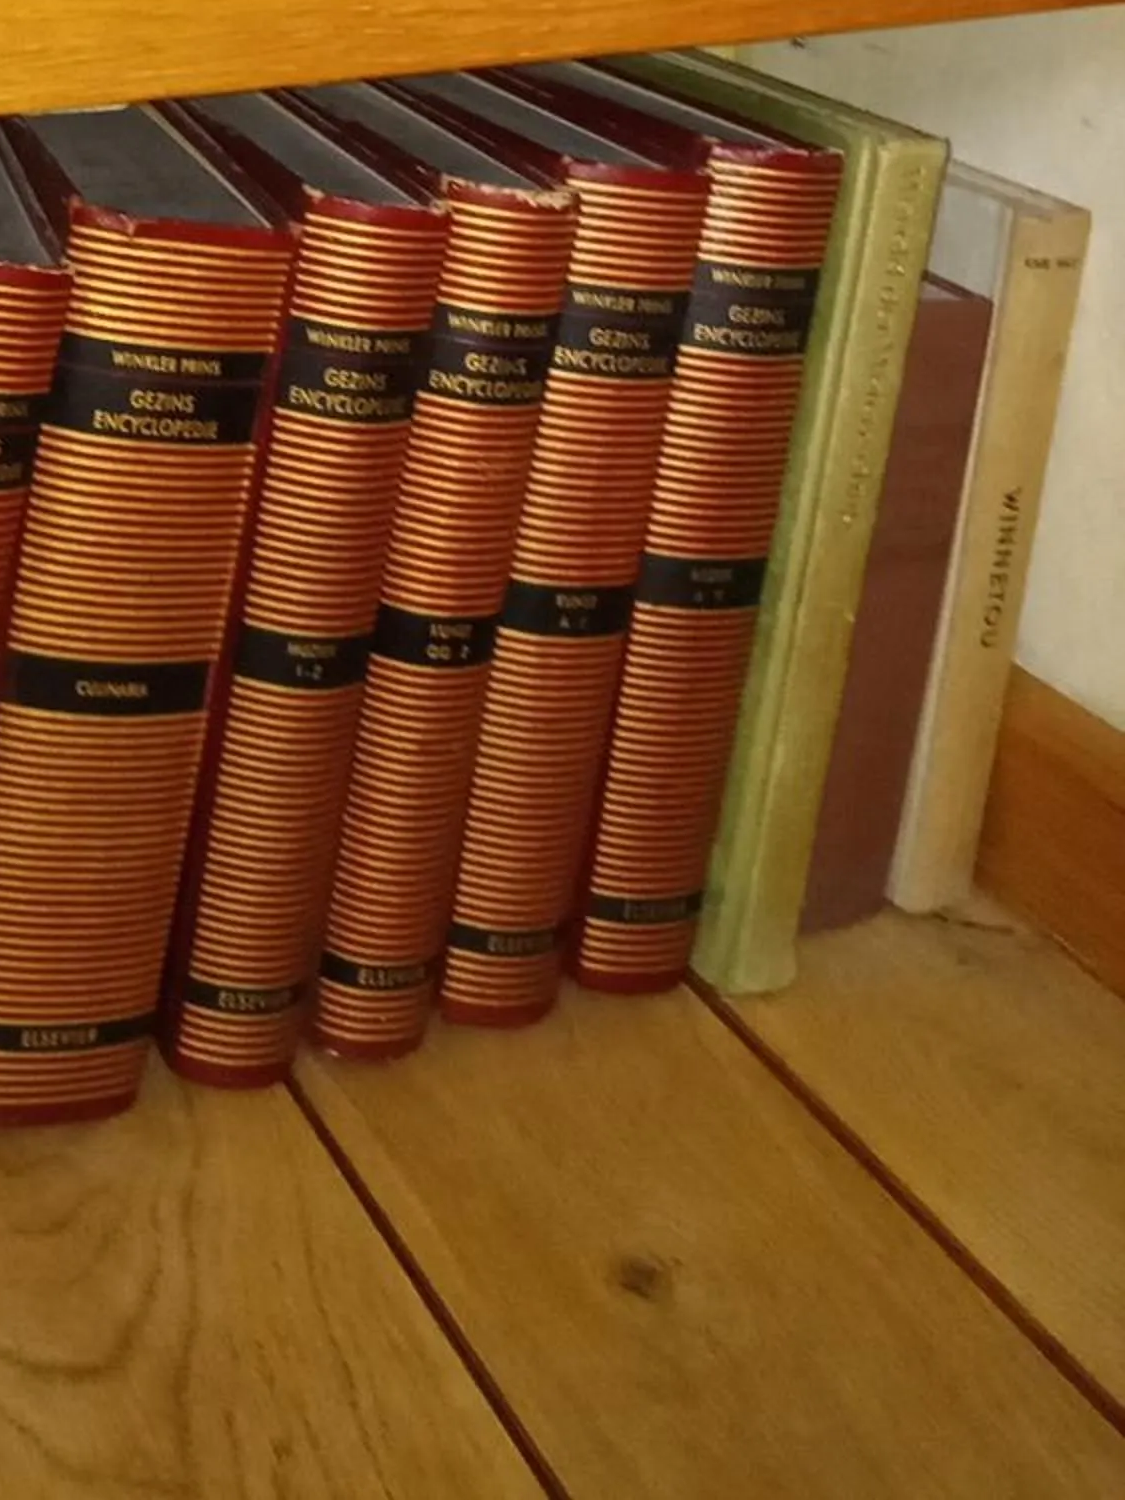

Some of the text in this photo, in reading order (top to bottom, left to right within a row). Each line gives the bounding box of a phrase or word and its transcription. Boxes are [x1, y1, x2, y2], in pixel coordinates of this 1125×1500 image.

[304, 324, 373, 353] WINKLER
[111, 348, 177, 374] WINKLER
[322, 366, 387, 392] GEZINS
[128, 387, 196, 414] GEZINS
[92, 408, 219, 440] ENCYCLOPEDIE
[979, 484, 1024, 650] WINNETOU
[75, 679, 150, 698] CULINARIA
[20, 1027, 99, 1049] ELSEVIER
